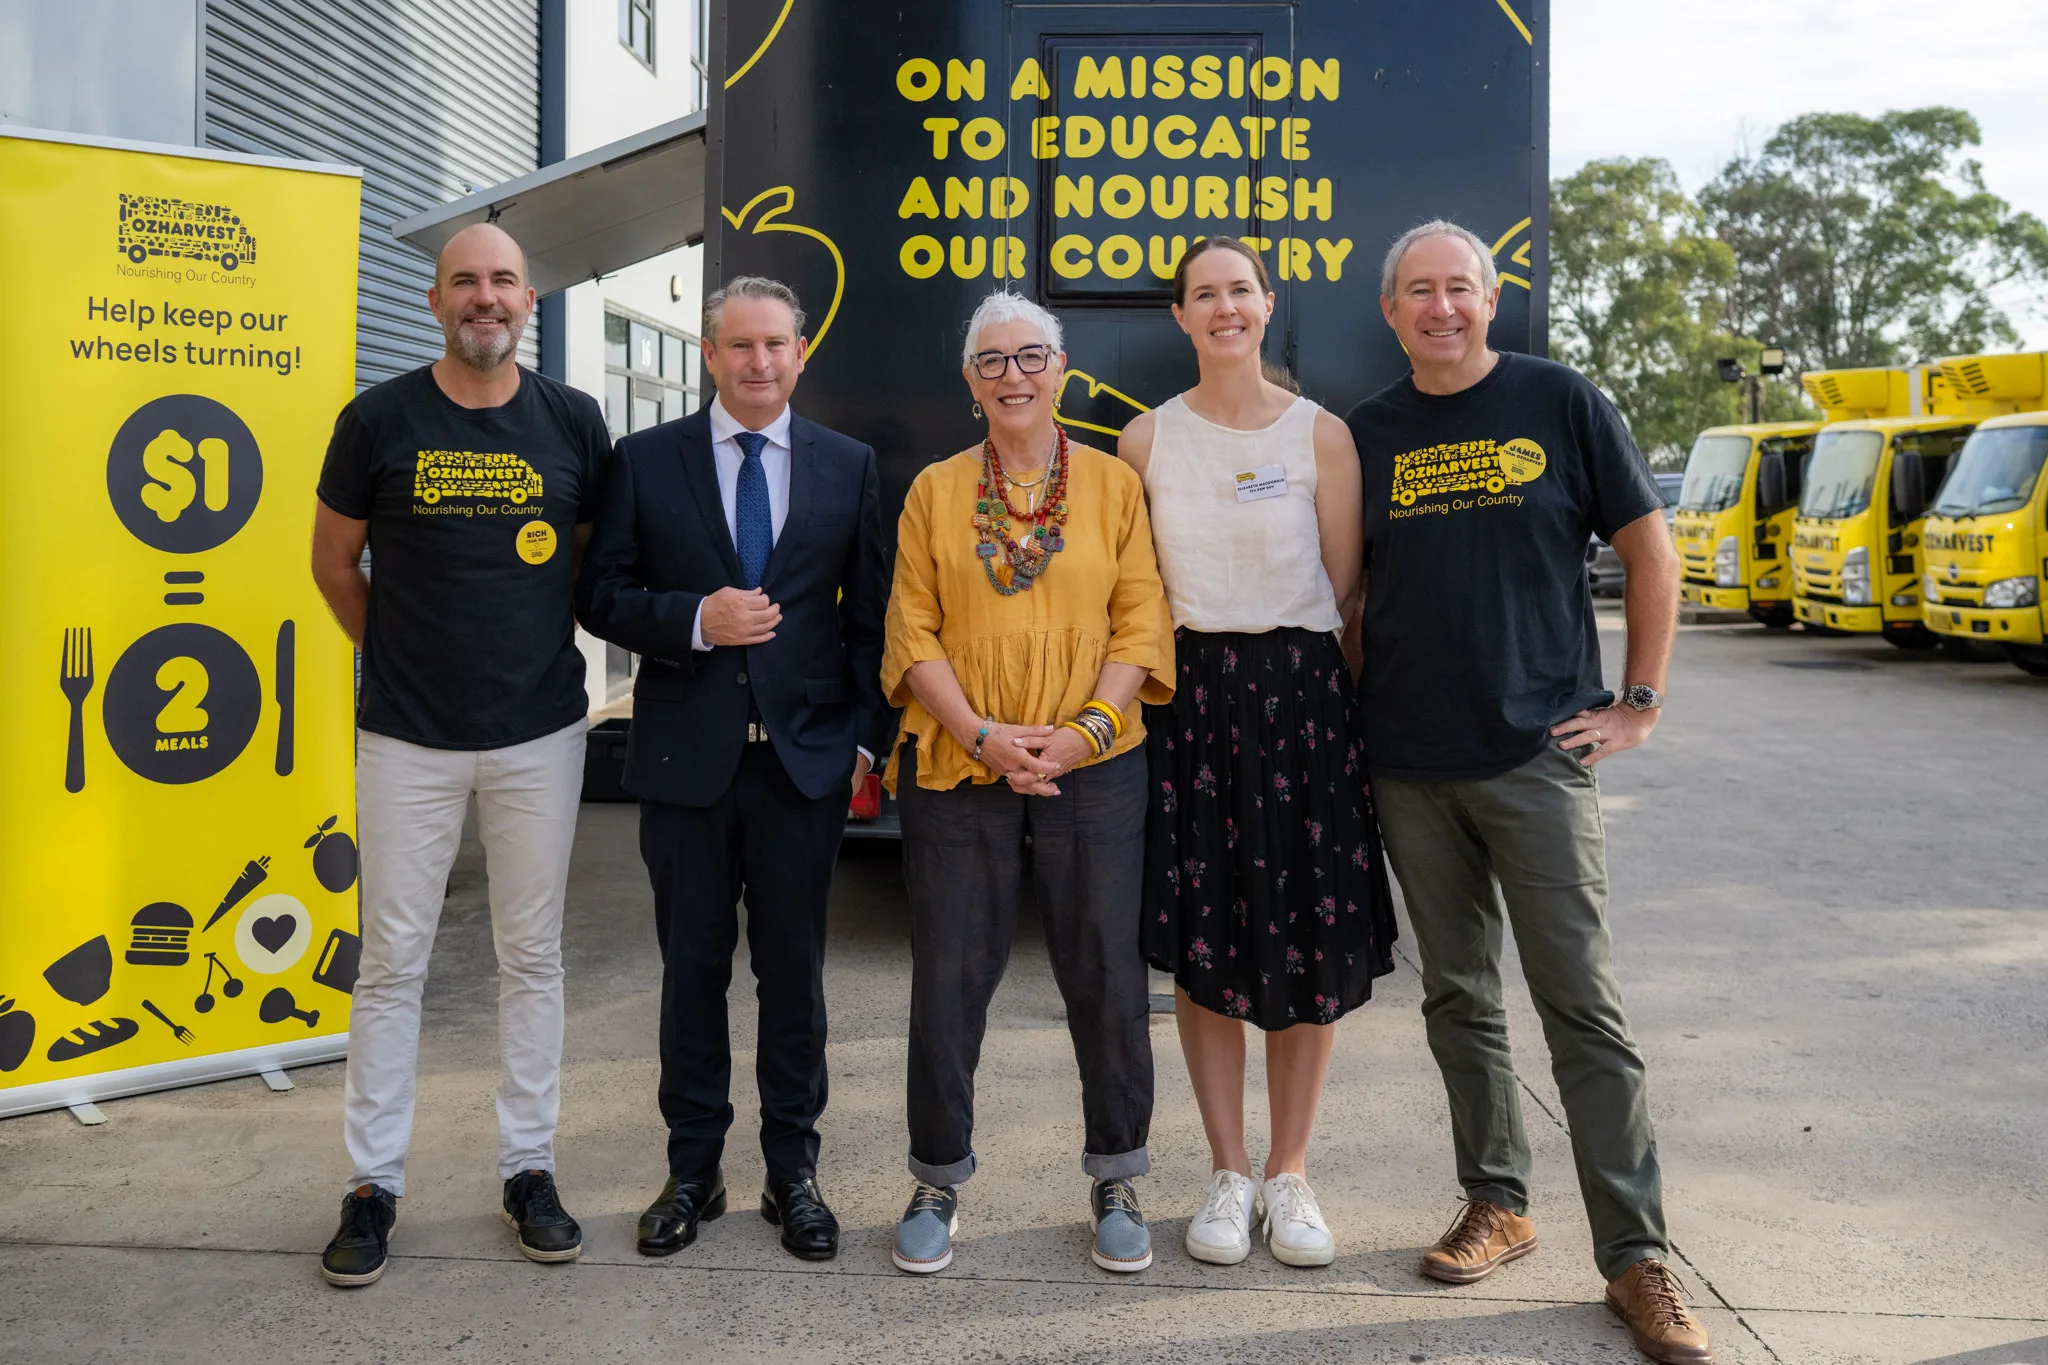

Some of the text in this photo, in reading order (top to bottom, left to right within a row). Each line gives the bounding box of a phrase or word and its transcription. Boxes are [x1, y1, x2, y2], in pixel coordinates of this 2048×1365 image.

[896, 55, 1340, 102] ON A MISSION
[923, 115, 1311, 161] TO EDUCATE
[898, 174, 1333, 222] AND NOURISH
[132, 218, 236, 240] OZHARVEST
[899, 234, 1353, 282] OUR COUTRY
[116, 263, 257, 288] Nourishing Our Country
[88, 296, 288, 335] Help keep our
[70, 336, 301, 376] wheels turning!
[1509, 445, 1542, 461] JAMES
[141, 429, 230, 522] $1
[427, 467, 523, 479] OZHARVEST
[1403, 455, 1500, 481] OZHARVEST
[413, 504, 544, 517] Nourishing Our Country
[1389, 493, 1525, 520] Nourishing Our Country
[526, 530, 547, 539] RICH
[155, 655, 209, 733] 2
[155, 735, 208, 752] MEALS
